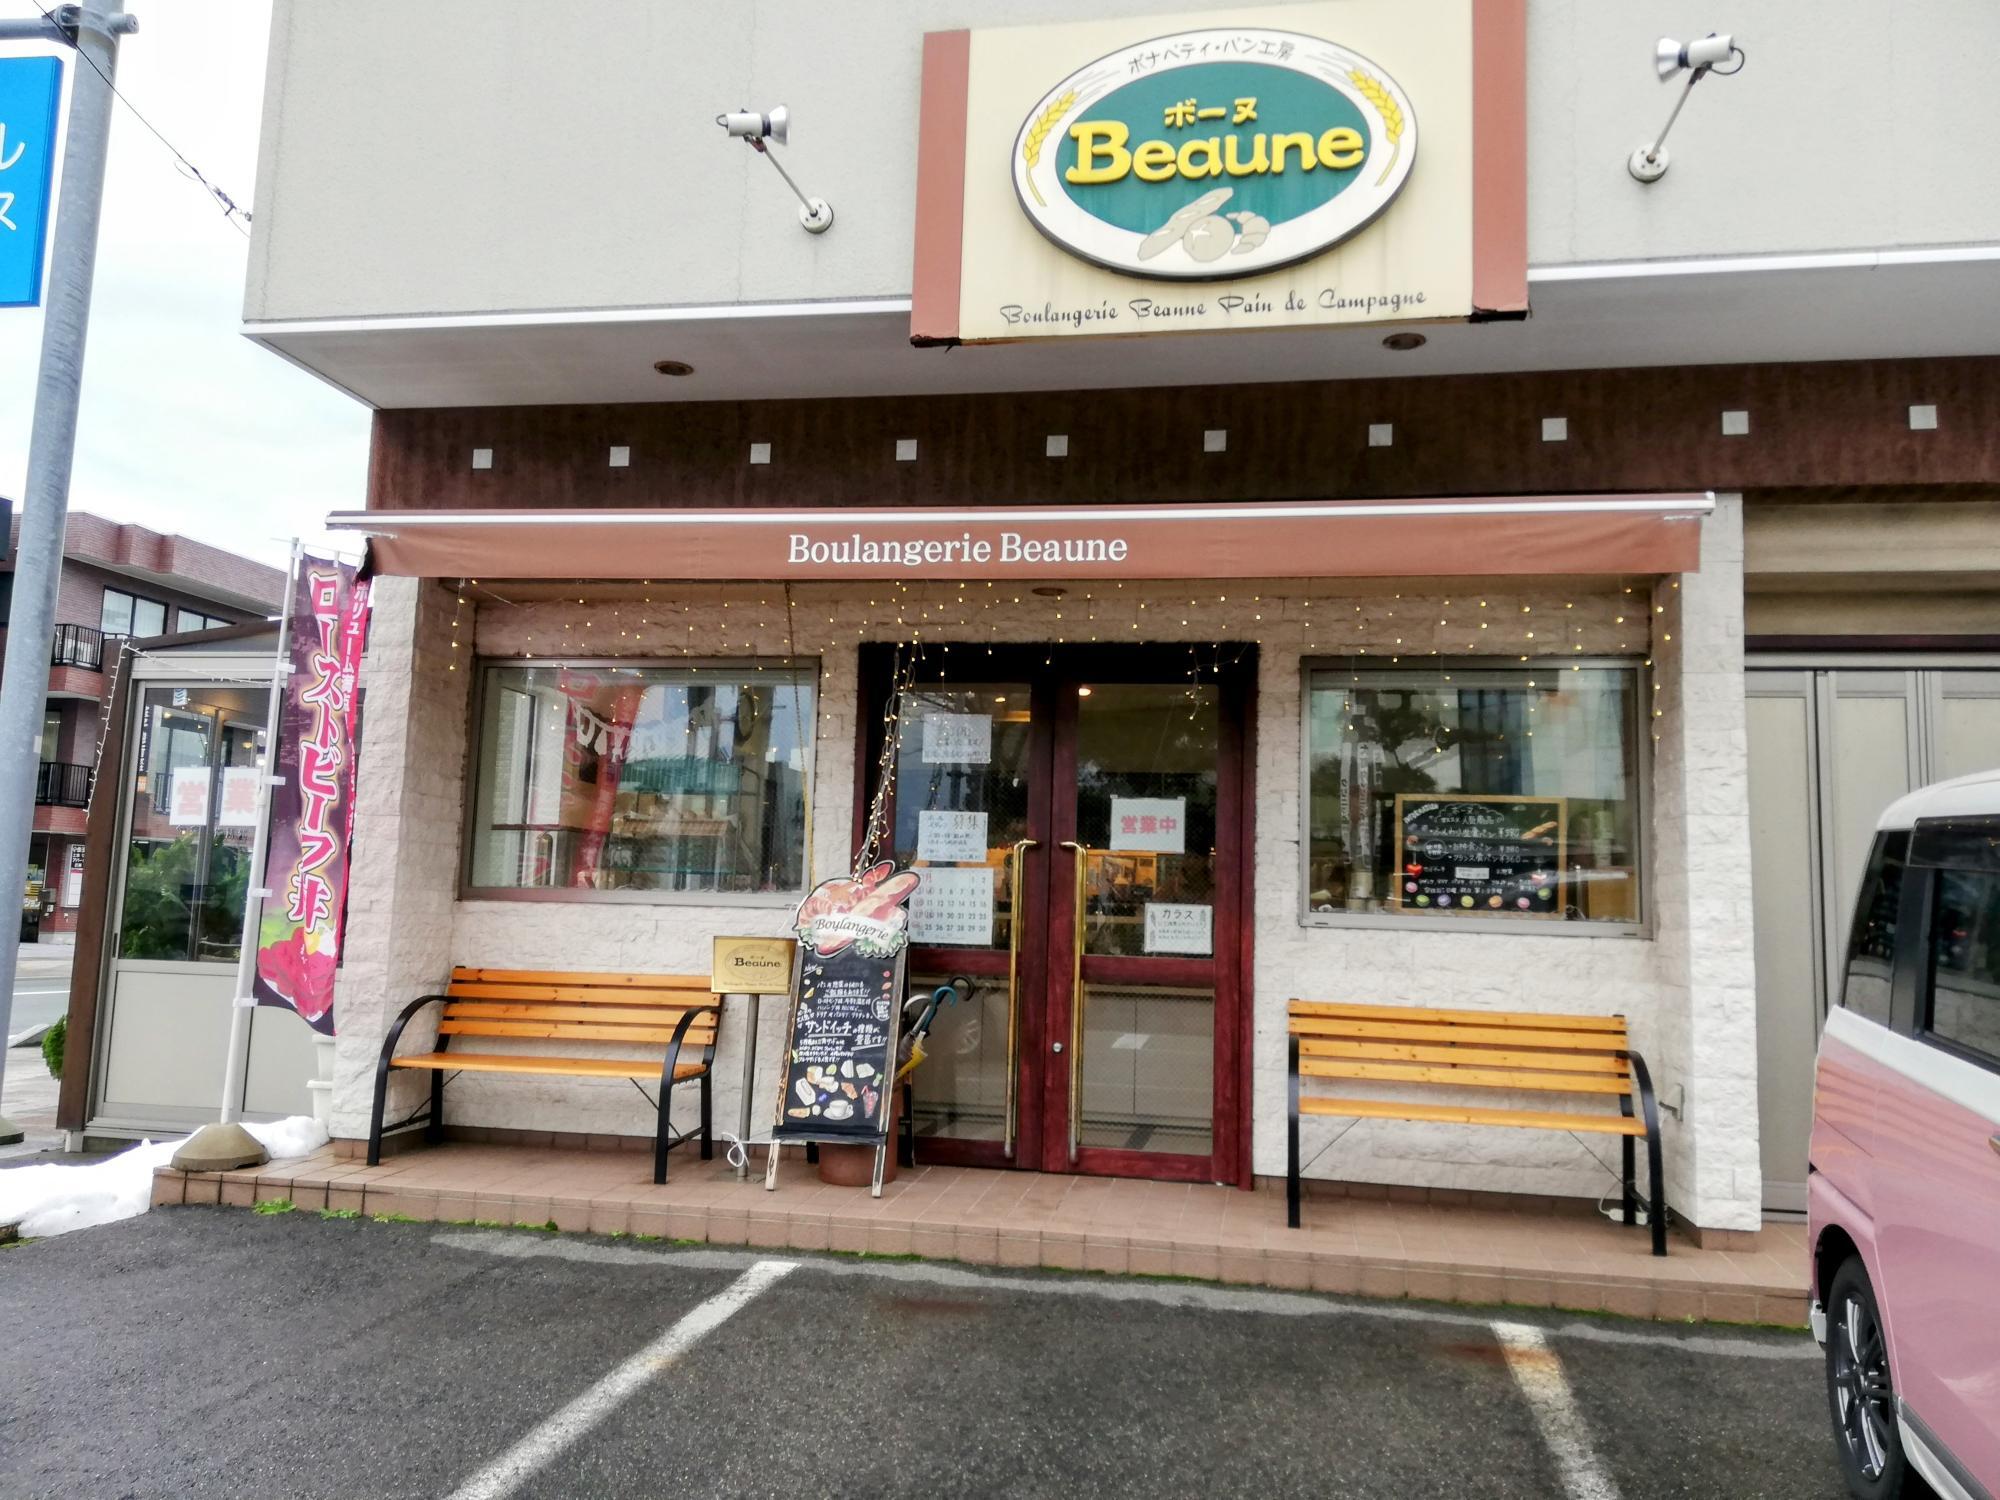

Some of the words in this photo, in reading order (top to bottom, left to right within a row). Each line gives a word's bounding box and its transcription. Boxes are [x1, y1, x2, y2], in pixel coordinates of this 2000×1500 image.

[1164, 97, 1258, 128] ボーヌ
[1065, 120, 1365, 184] Beaune
[1000, 300, 1118, 328] Boulangerie
[1217, 293, 1272, 316] Pain
[1285, 289, 1306, 312] de
[1318, 288, 1426, 314] Campagne
[788, 533, 991, 566] Boulangerie
[1000, 532, 1127, 561] Beaune
[287, 571, 344, 933] ローストビーフ丼
[1120, 815, 1178, 835] 営業中
[734, 957, 781, 968] Beaune
